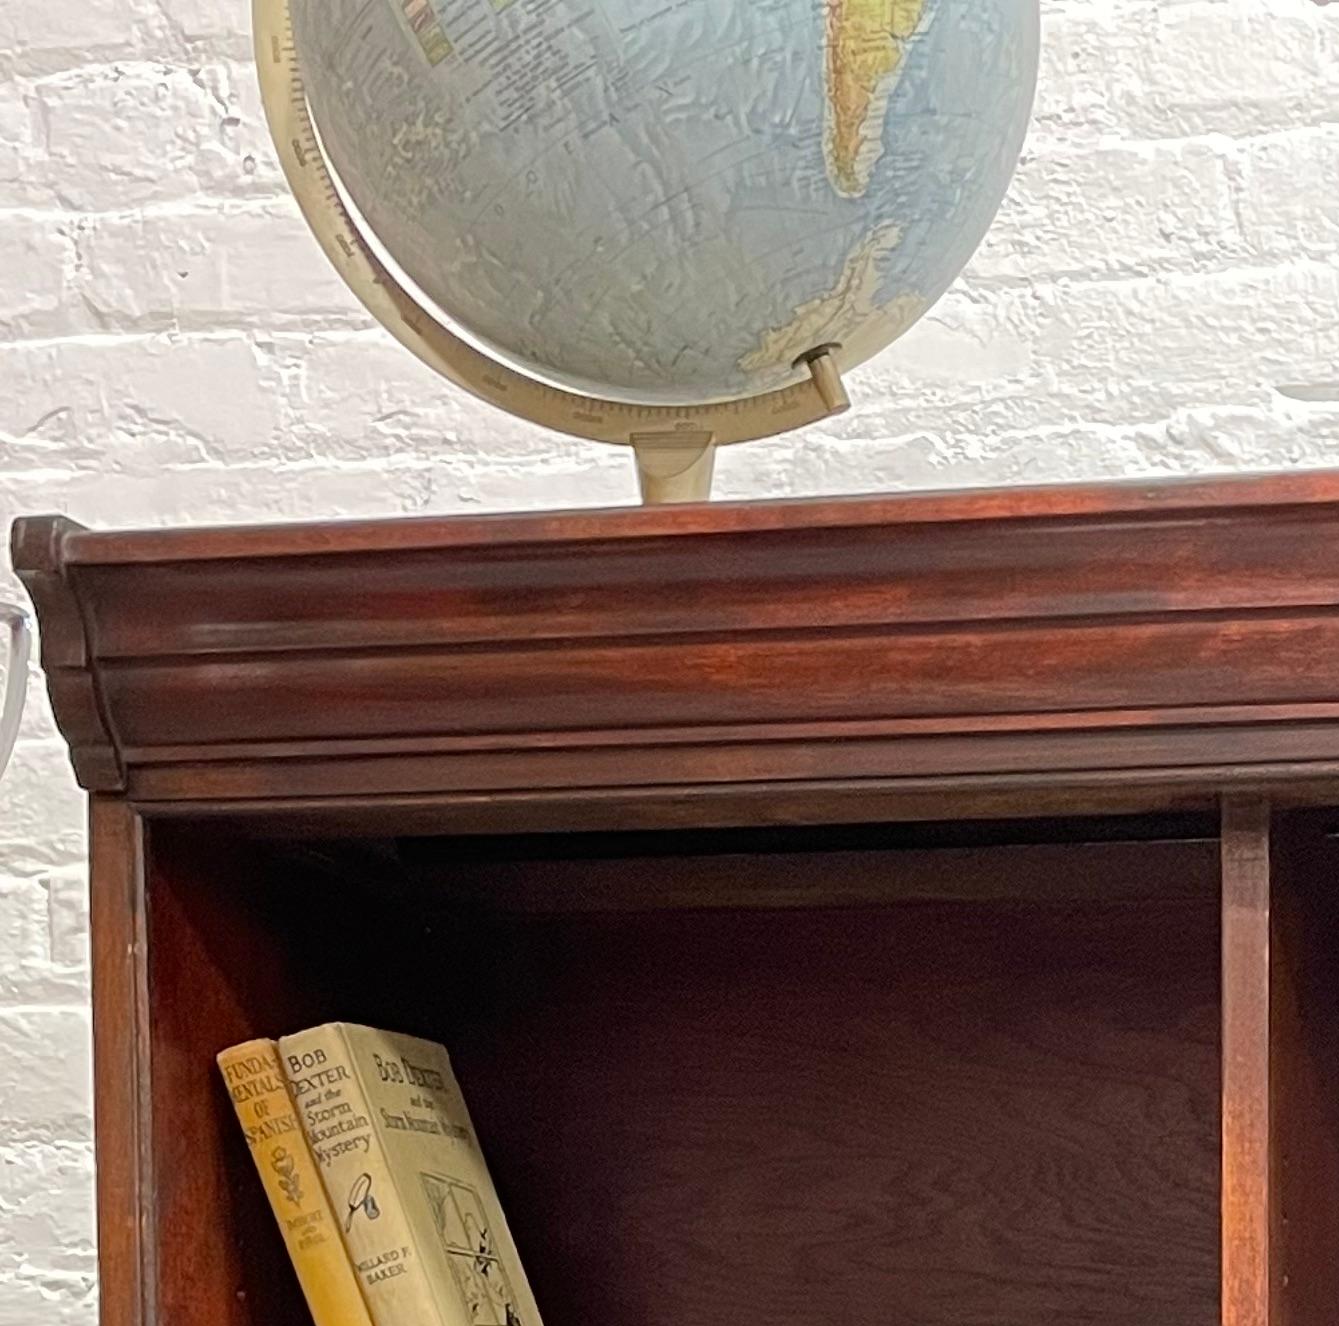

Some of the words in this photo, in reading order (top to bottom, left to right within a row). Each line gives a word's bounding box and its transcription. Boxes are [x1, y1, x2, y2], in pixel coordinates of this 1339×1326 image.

[287, 1049, 328, 1074] BOB
[289, 1065, 351, 1098] DEXTER
[307, 1102, 352, 1127] Storm
